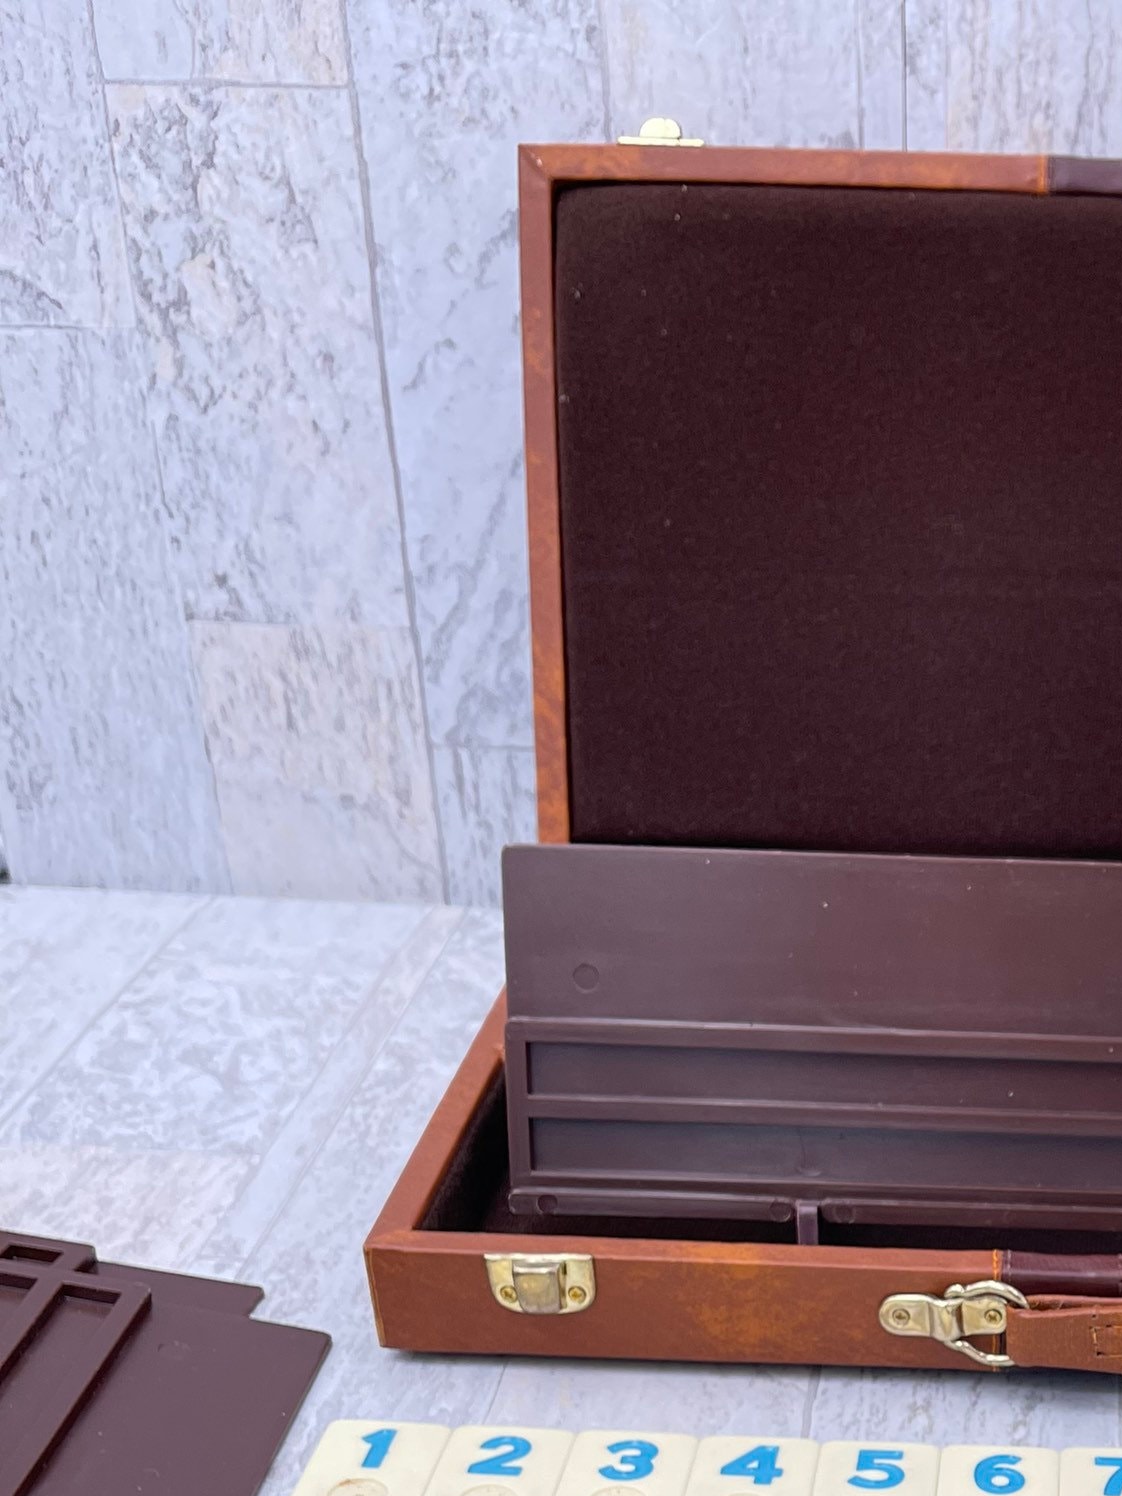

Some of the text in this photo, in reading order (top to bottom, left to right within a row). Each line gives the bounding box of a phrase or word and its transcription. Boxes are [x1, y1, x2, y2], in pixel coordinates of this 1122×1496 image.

[361, 1428, 397, 1469] 1
[466, 1435, 533, 1477] 2
[598, 1439, 660, 1482] 3
[719, 1444, 784, 1486] 4
[847, 1449, 906, 1491] 5
[972, 1453, 1026, 1496] 6
